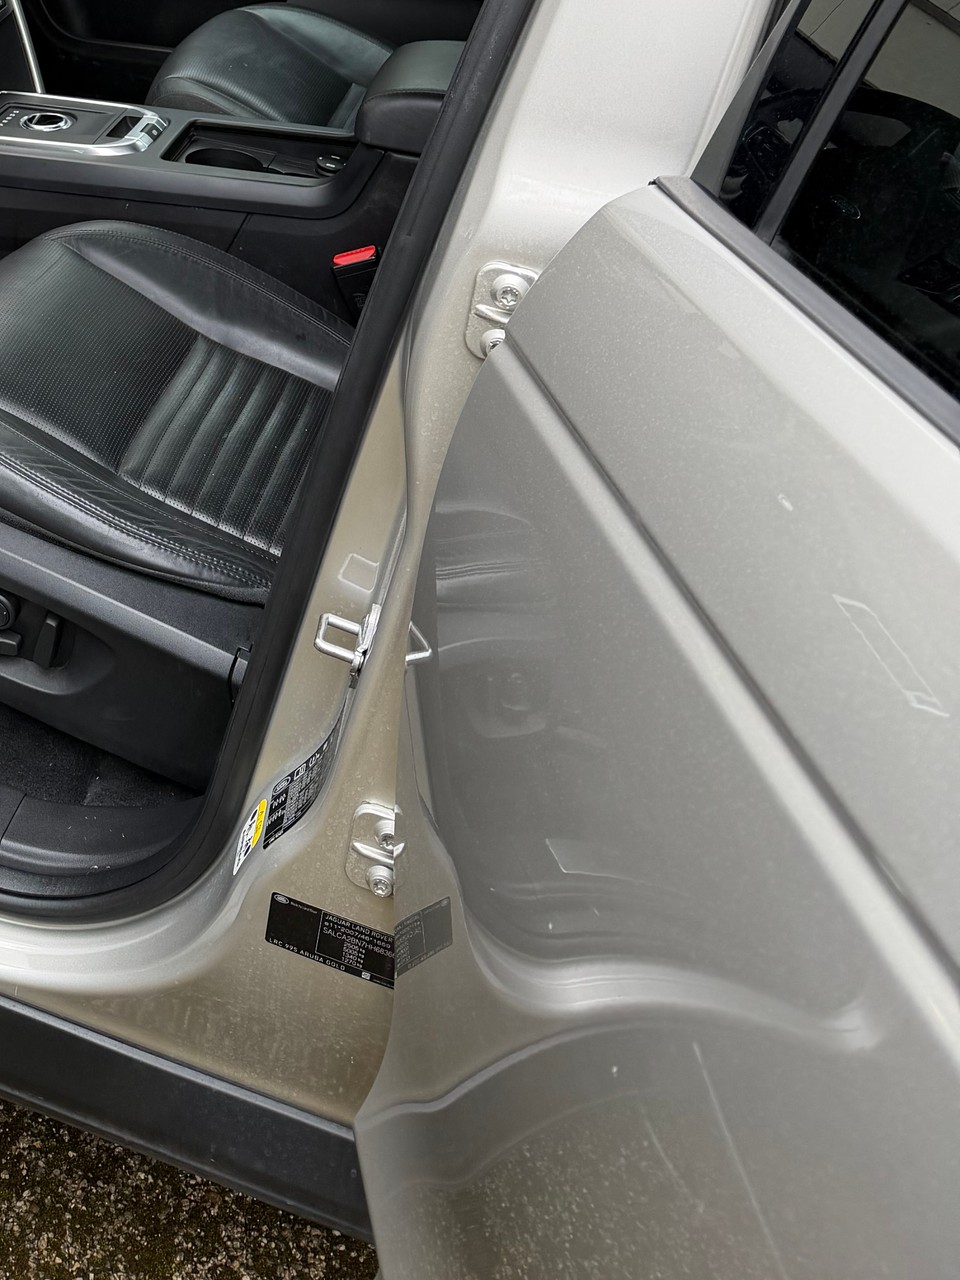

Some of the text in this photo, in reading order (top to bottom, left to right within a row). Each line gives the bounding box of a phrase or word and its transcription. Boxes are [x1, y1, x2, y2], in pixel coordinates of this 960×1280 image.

[325, 915, 350, 928] JAGUAR
[352, 923, 370, 935] LAND
[269, 938, 282, 947] LRC
[300, 949, 324, 963] ARUBA
[326, 958, 345, 971] GOLD
